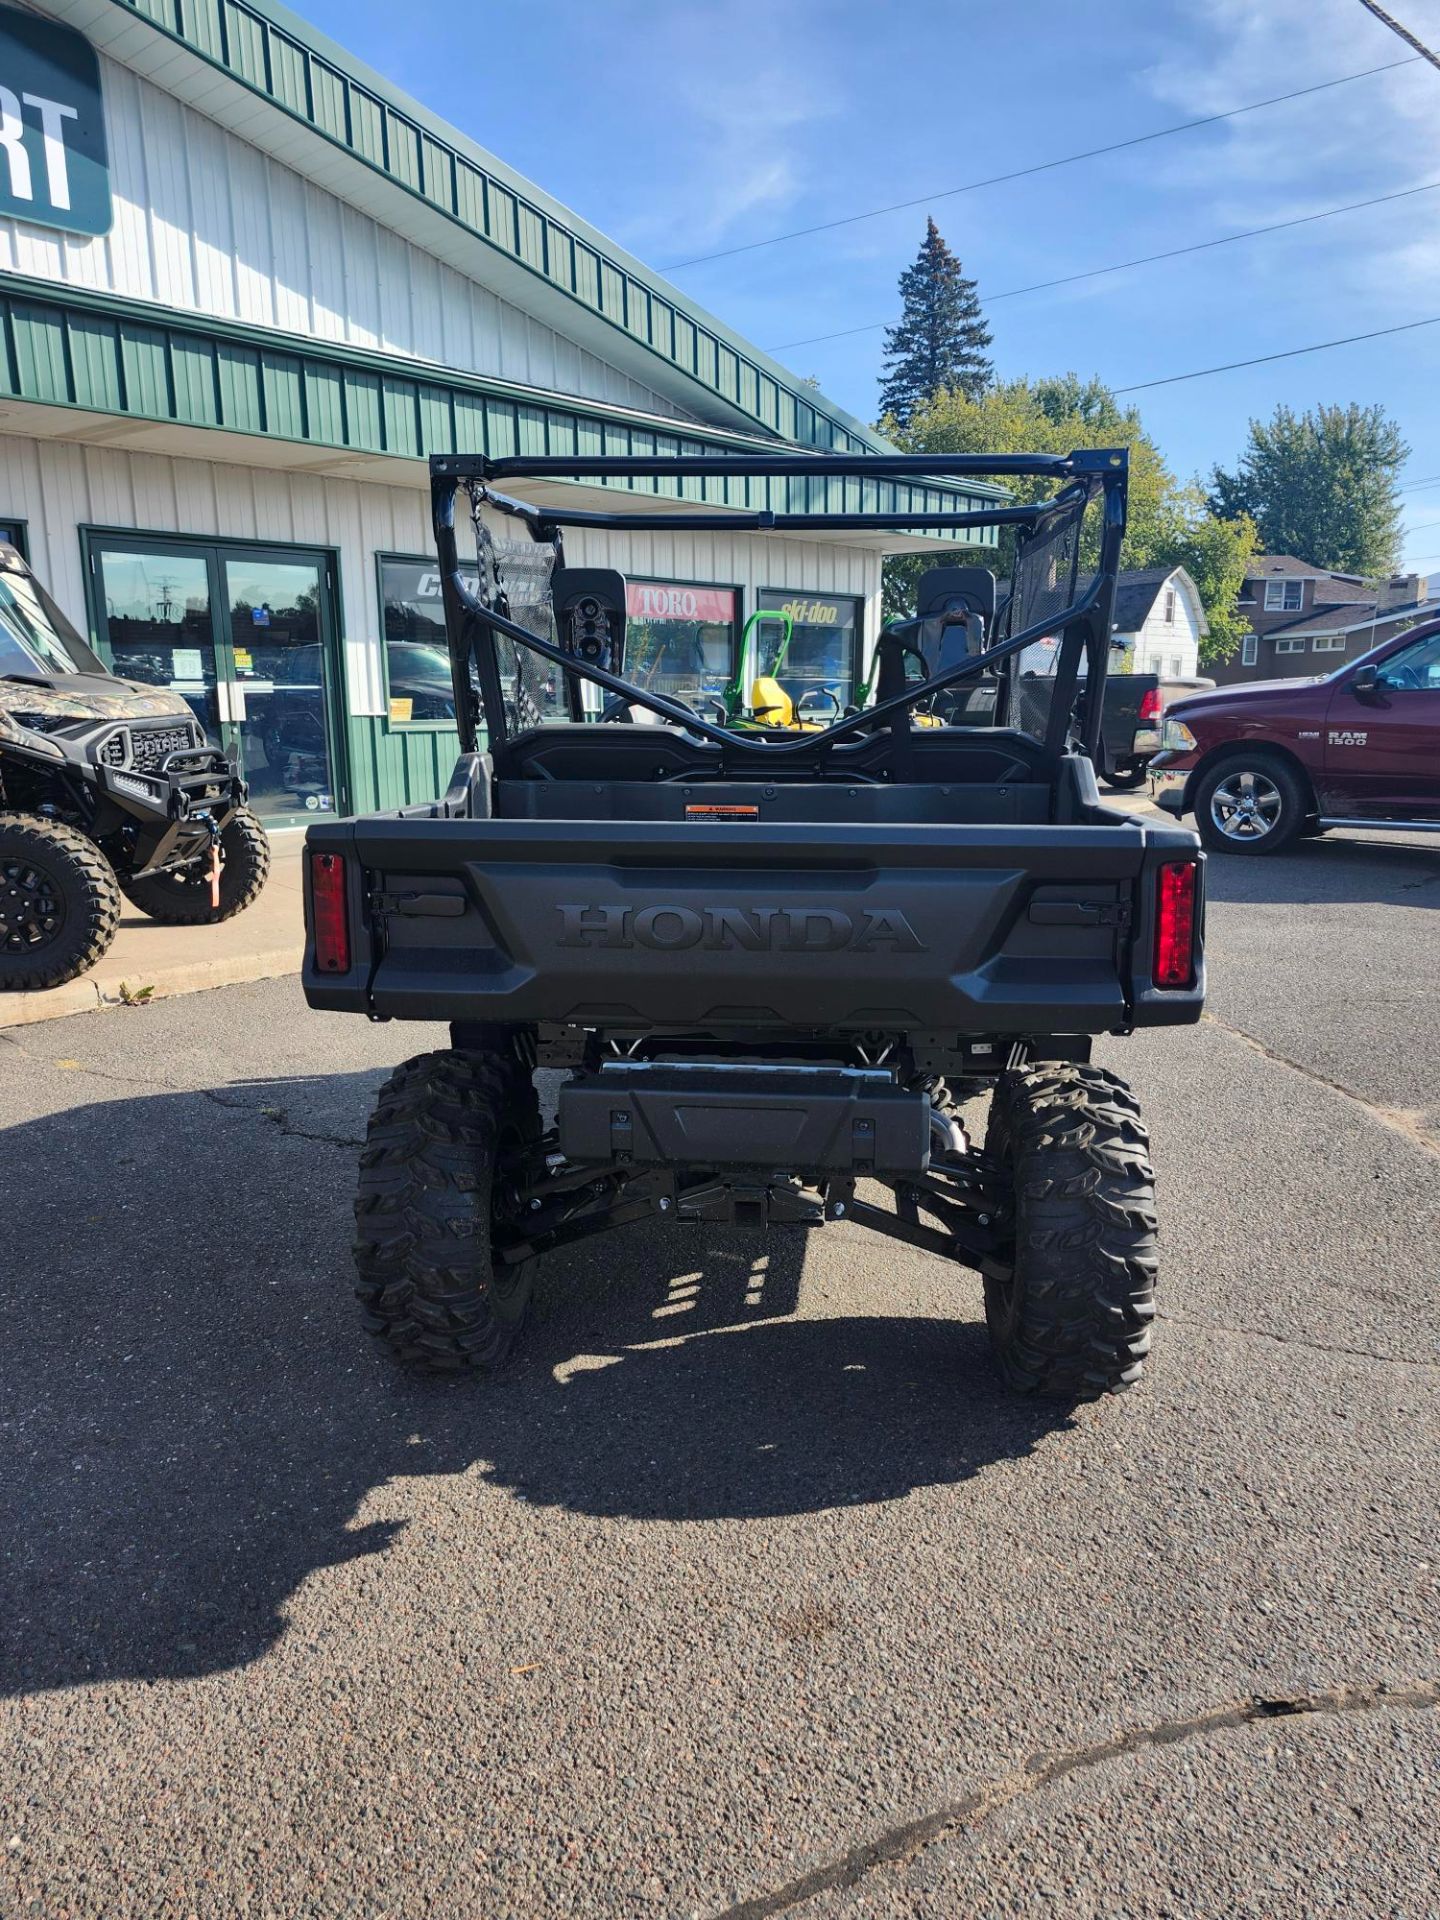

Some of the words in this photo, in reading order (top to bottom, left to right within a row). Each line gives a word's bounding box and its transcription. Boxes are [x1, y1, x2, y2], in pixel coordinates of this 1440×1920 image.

[639, 588, 697, 616] TORO
[1328, 731, 1368, 739] RAM
[1328, 738, 1367, 746] 1500
[133, 736, 189, 755] POLARIS
[555, 904, 929, 951] HONDA
